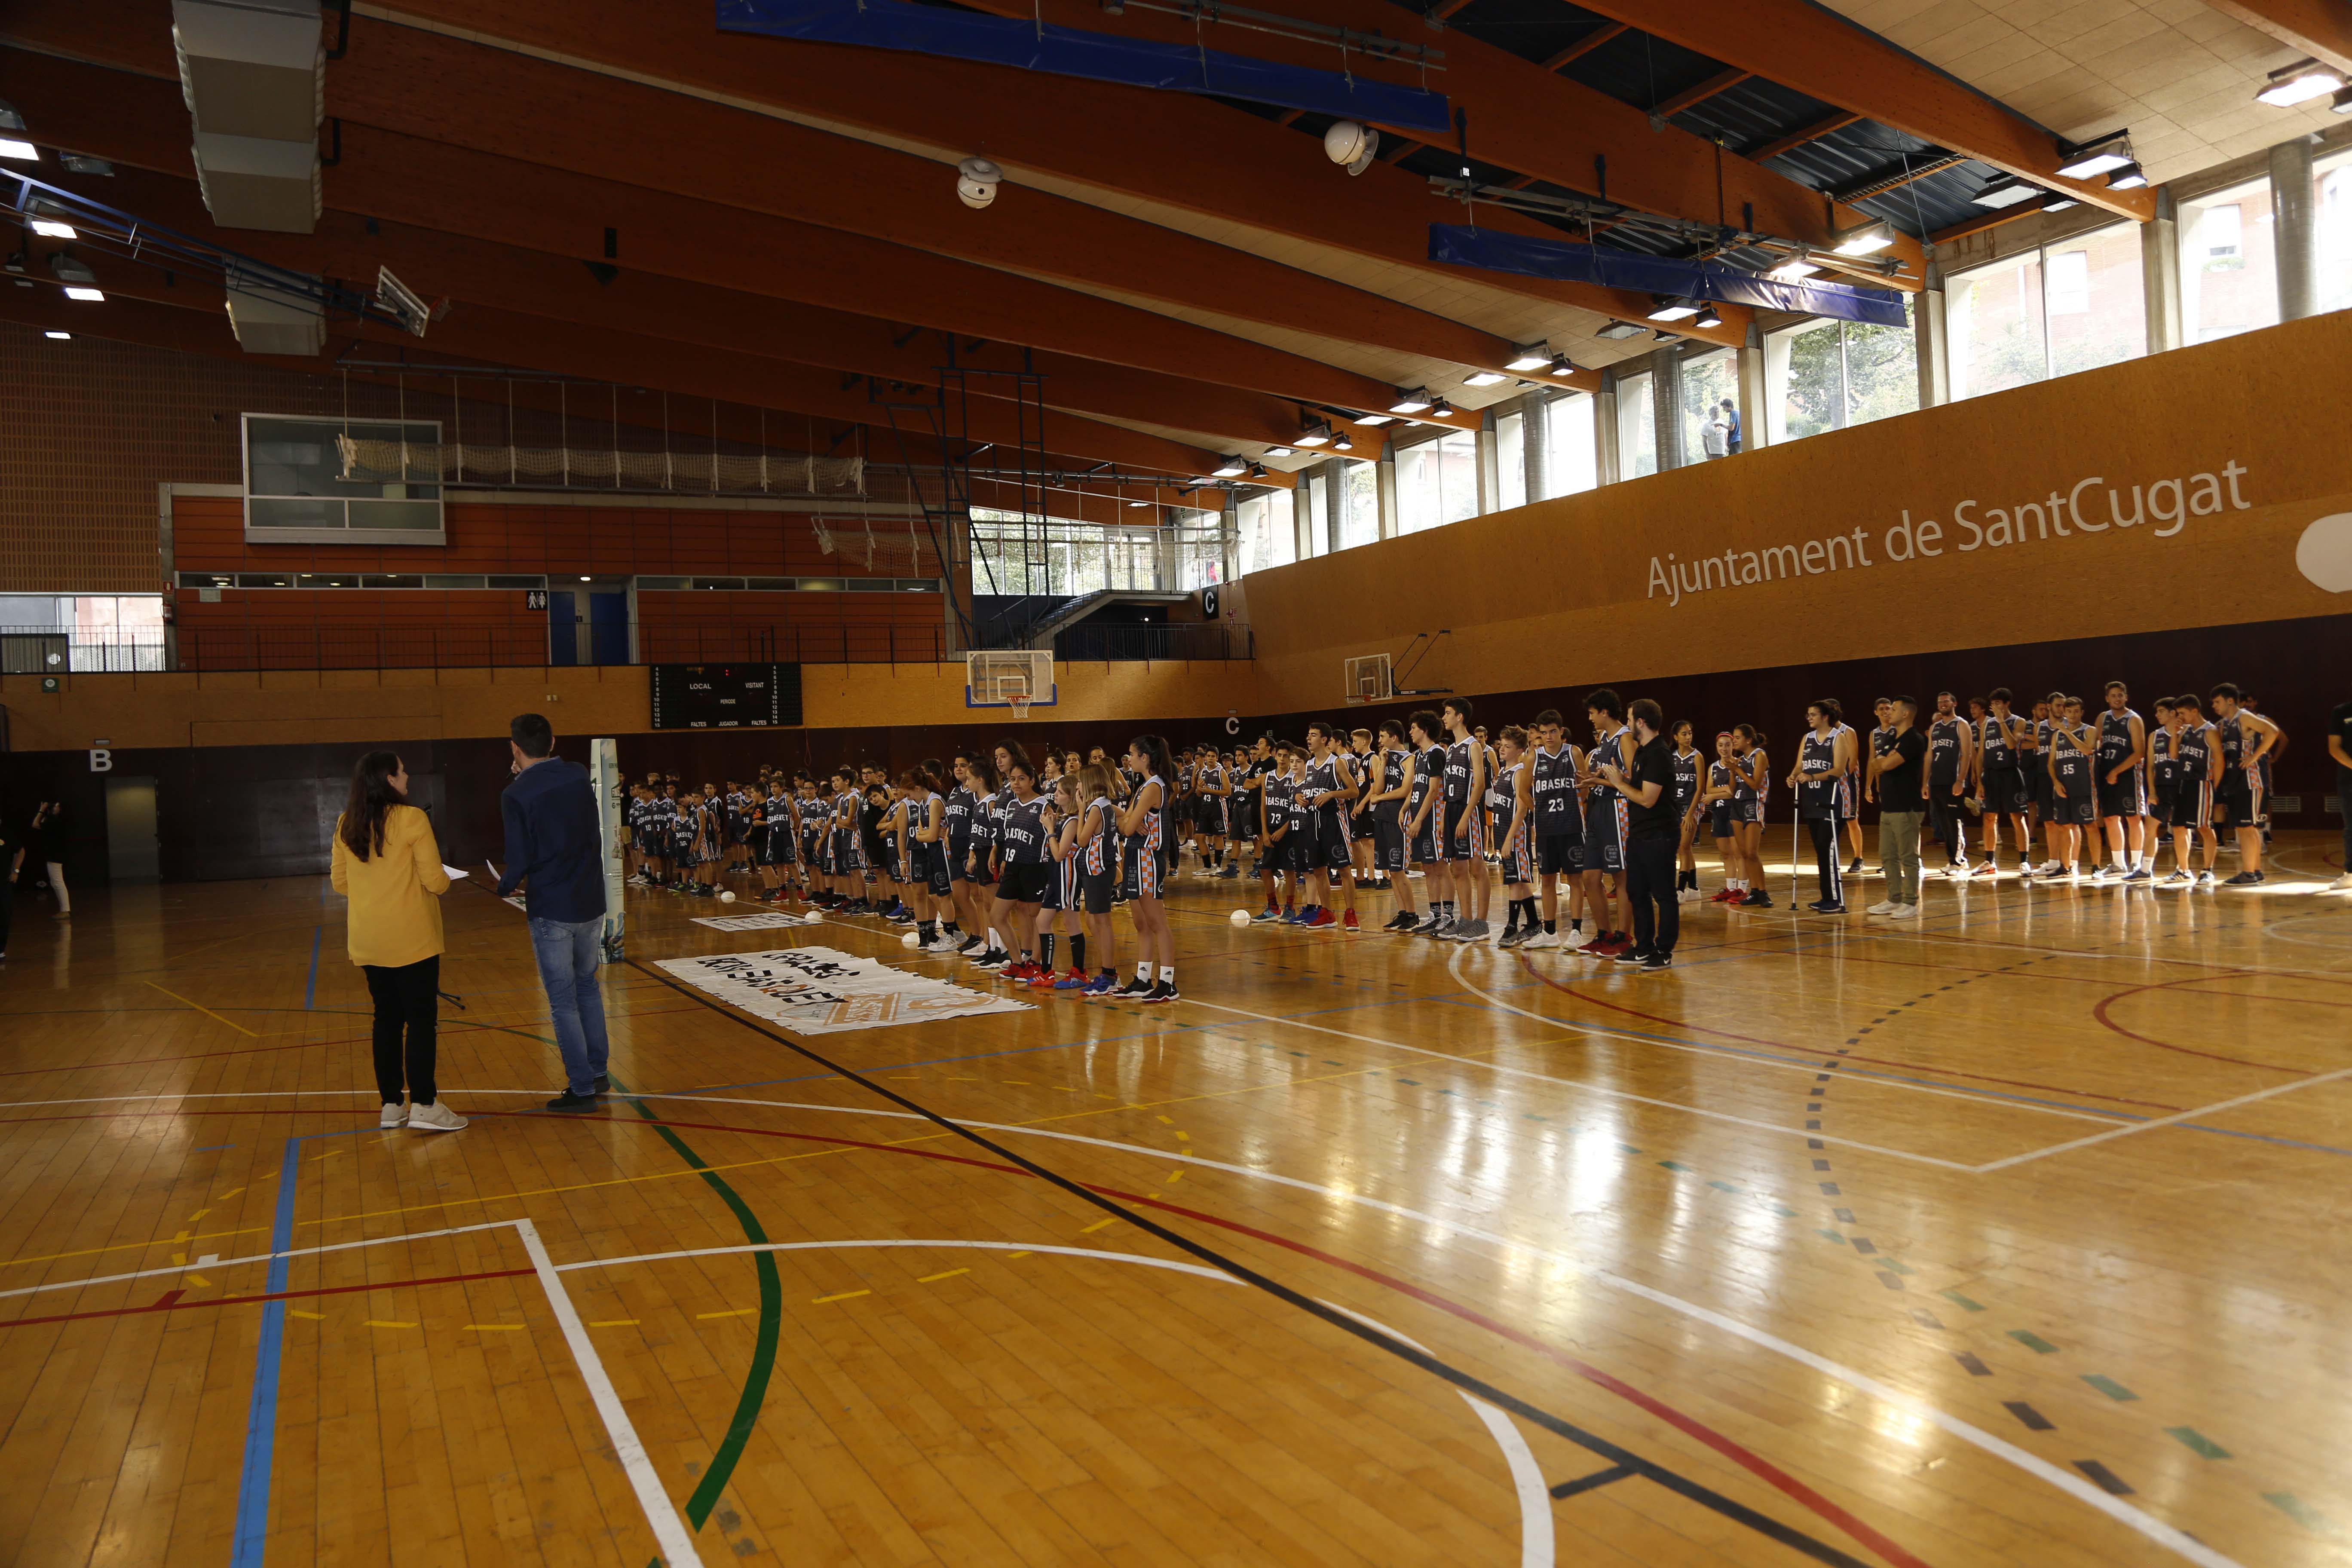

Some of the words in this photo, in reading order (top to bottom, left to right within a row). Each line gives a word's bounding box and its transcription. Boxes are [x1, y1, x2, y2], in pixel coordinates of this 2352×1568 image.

[1647, 526, 1872, 607] Ajuntament
[1885, 509, 1942, 561] de
[1954, 459, 2251, 551] SantCugat
[1205, 591, 1214, 613] C
[1226, 717, 1239, 735] C
[90, 749, 112, 772] B
[1997, 751, 2003, 760] 2
[2104, 750, 2117, 760] 37
[2165, 768, 2172, 778] 3
[1449, 784, 1454, 796] 0
[1535, 778, 1575, 793] QBASKET
[1677, 788, 1684, 798] 5
[1548, 798, 1565, 812] 23
[1271, 812, 1282, 824] 73
[1291, 819, 1299, 830] 13
[803, 829, 809, 837] 21
[887, 838, 894, 847] 12
[1005, 847, 1016, 862] 19
